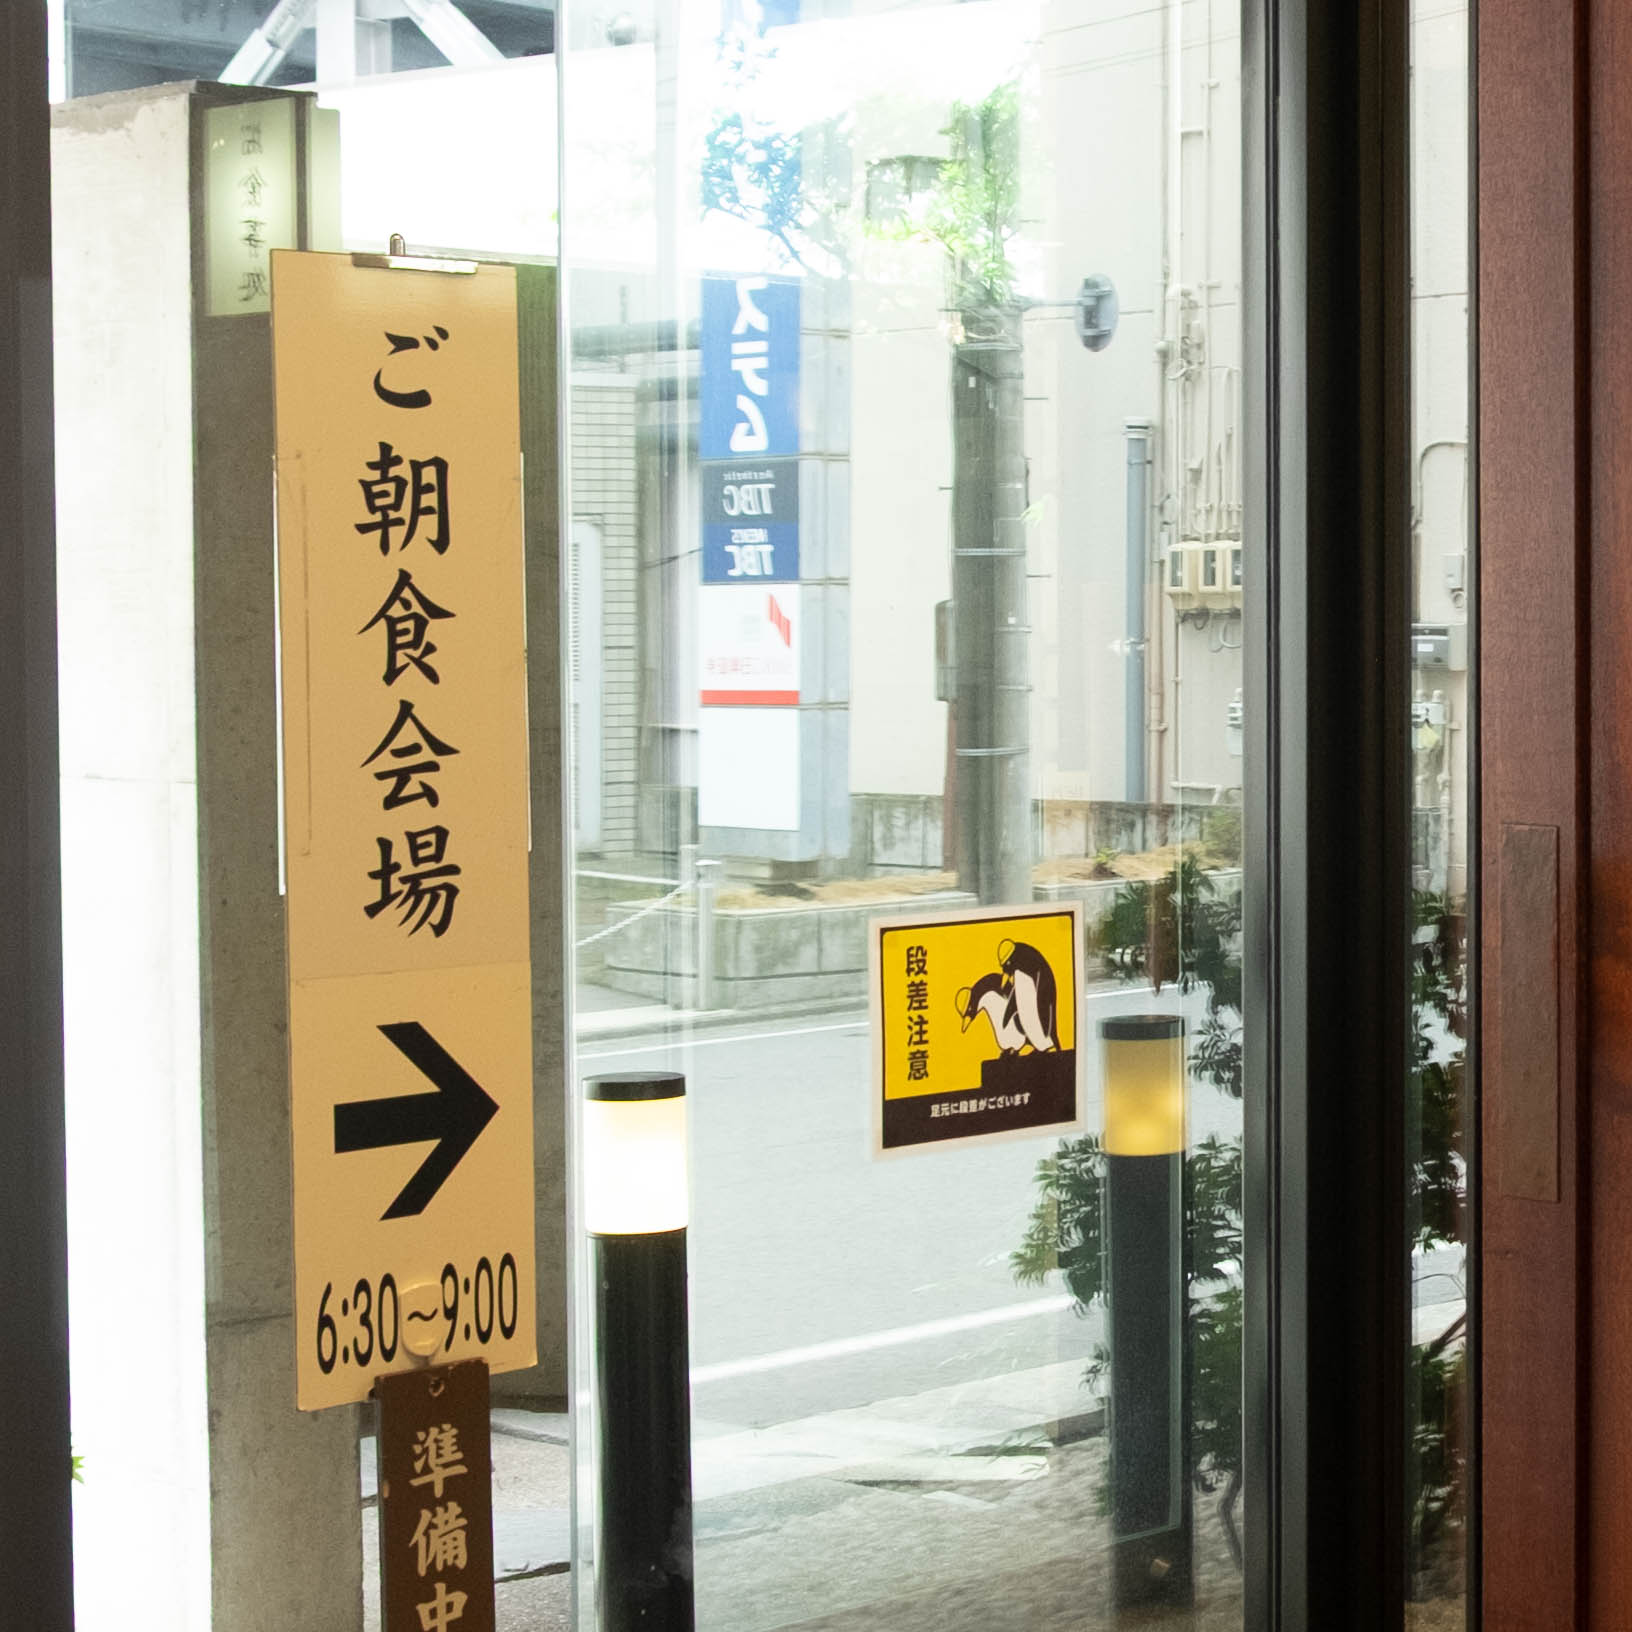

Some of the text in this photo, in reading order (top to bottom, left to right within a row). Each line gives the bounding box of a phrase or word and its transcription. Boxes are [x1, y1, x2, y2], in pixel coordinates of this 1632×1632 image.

[354, 326, 461, 939] ご朝食会場
[905, 945, 930, 1081] 段差注意
[930, 1092, 1032, 1118] 足元に段差がございます
